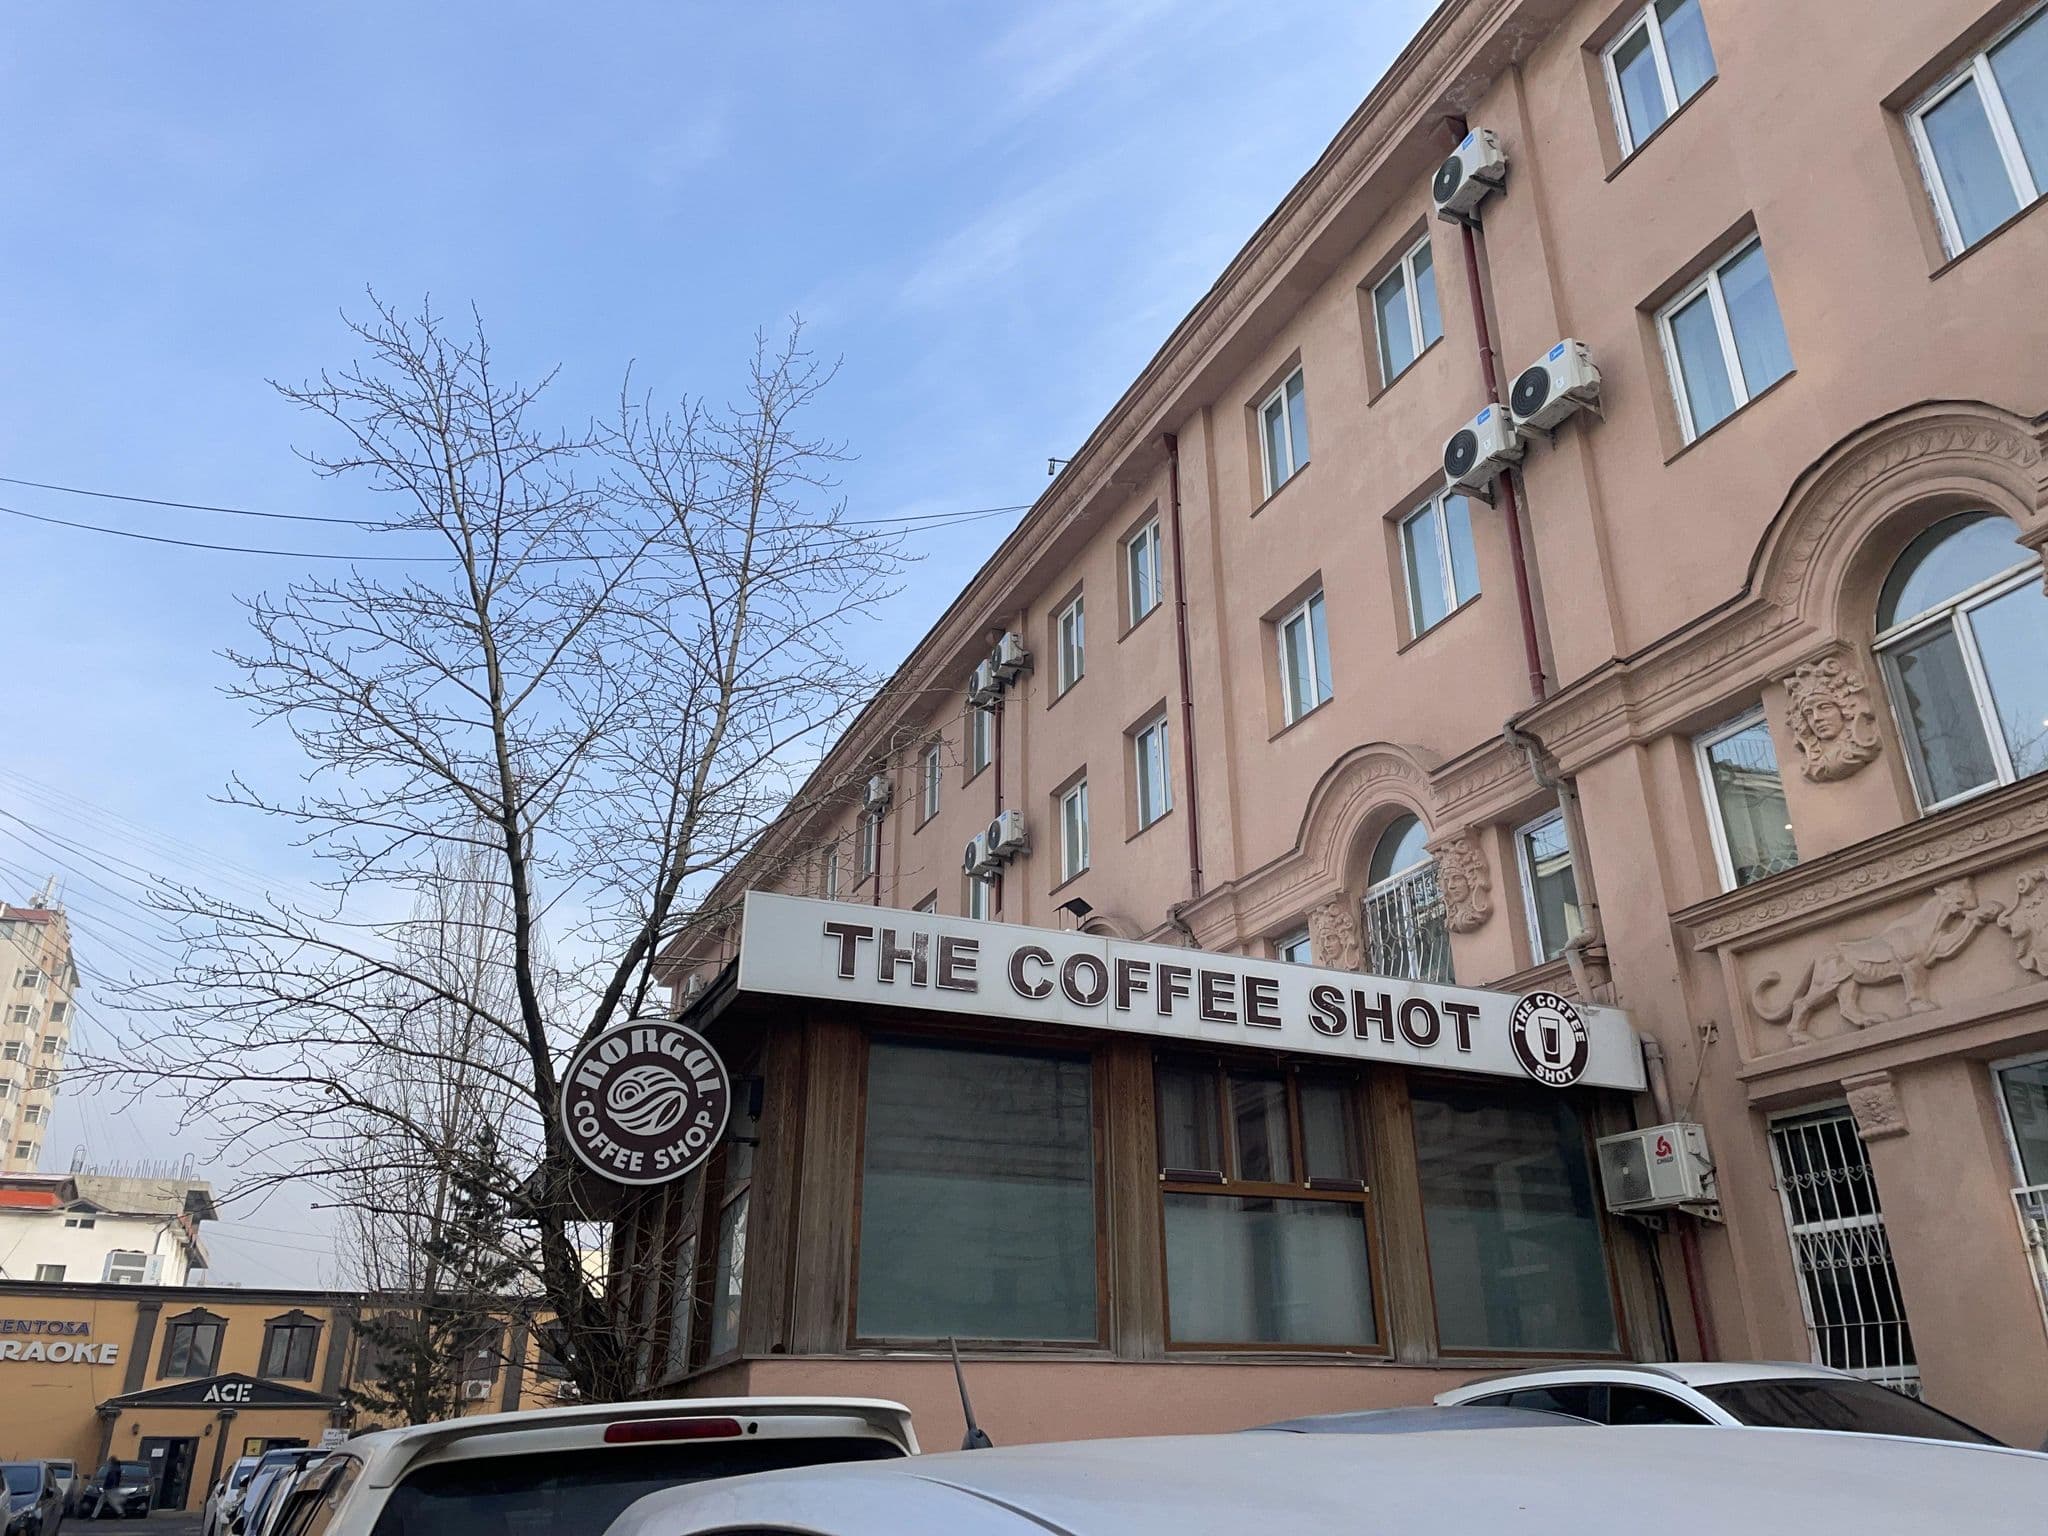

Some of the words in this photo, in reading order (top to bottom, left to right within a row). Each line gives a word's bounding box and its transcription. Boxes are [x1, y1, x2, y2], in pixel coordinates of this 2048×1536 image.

[824, 920, 980, 993] THE
[1008, 944, 1282, 1029] COFFEE
[1309, 984, 1481, 1052] SHOT
[1514, 1000, 1535, 1033] THE
[1536, 995, 1586, 1042] COFFEE
[1535, 1064, 1575, 1083] SHOT
[574, 1100, 645, 1172] COFFEE
[654, 1110, 715, 1170] SHOP
[0, 1319, 90, 1336] ENTOSA
[203, 1383, 253, 1402] ACE
